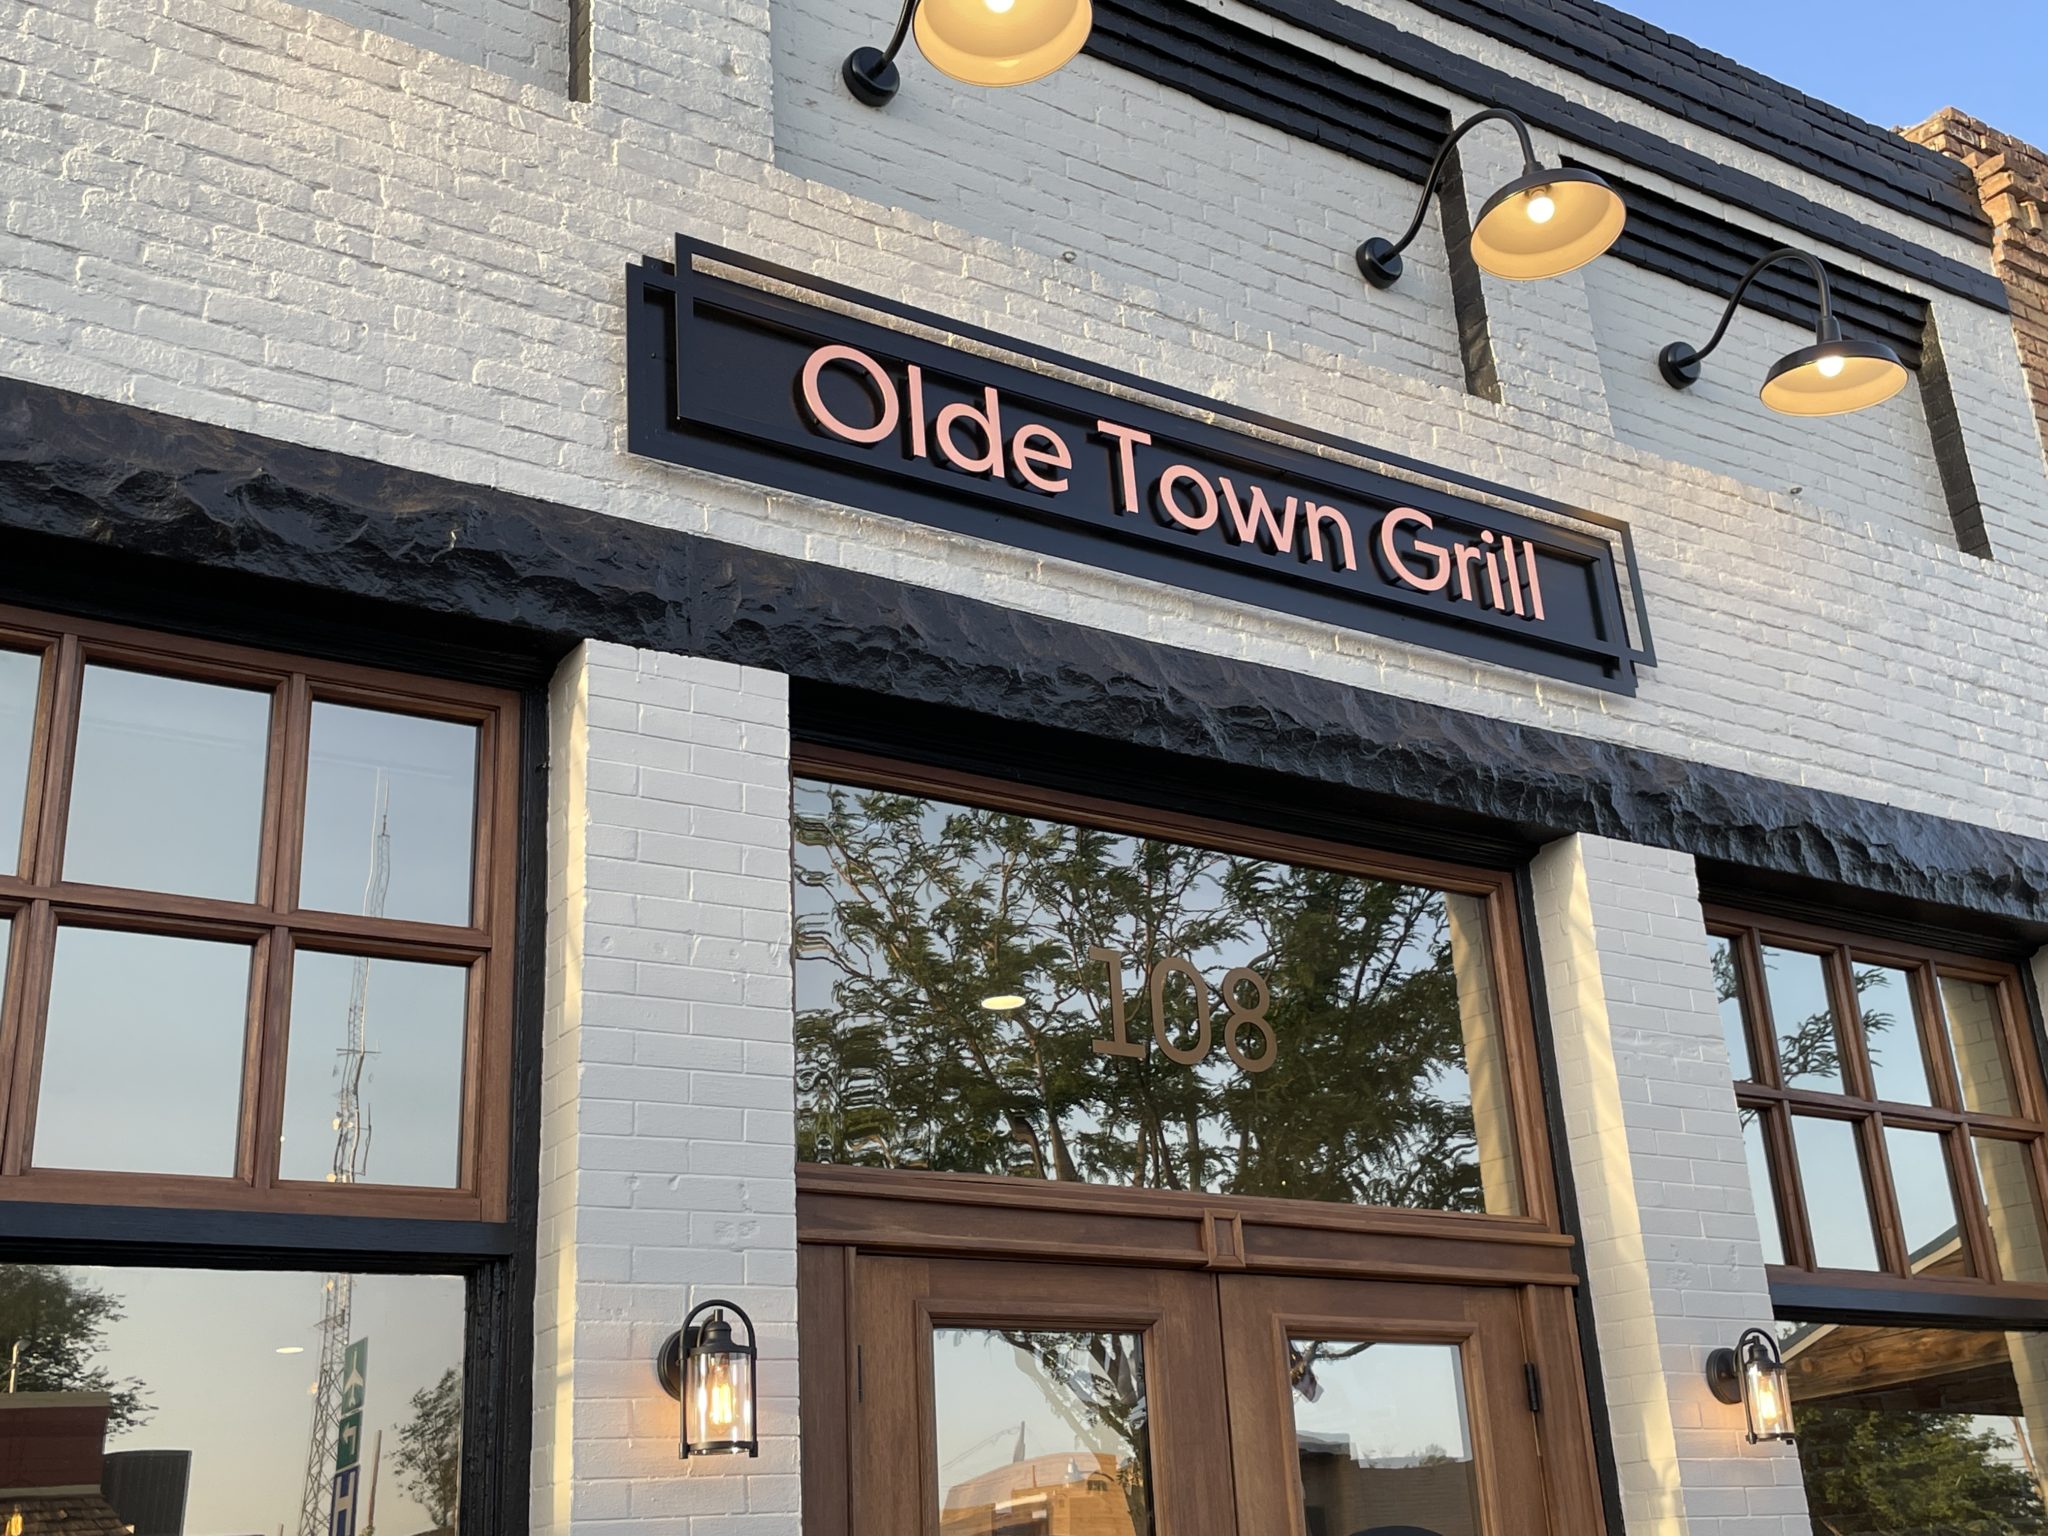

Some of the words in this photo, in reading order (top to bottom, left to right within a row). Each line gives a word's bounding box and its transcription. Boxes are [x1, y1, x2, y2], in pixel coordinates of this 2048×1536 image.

[802, 345, 1073, 493] Olde
[1097, 420, 1357, 572] Town
[1381, 507, 1545, 621] Grill
[1089, 945, 1278, 1073] 108
